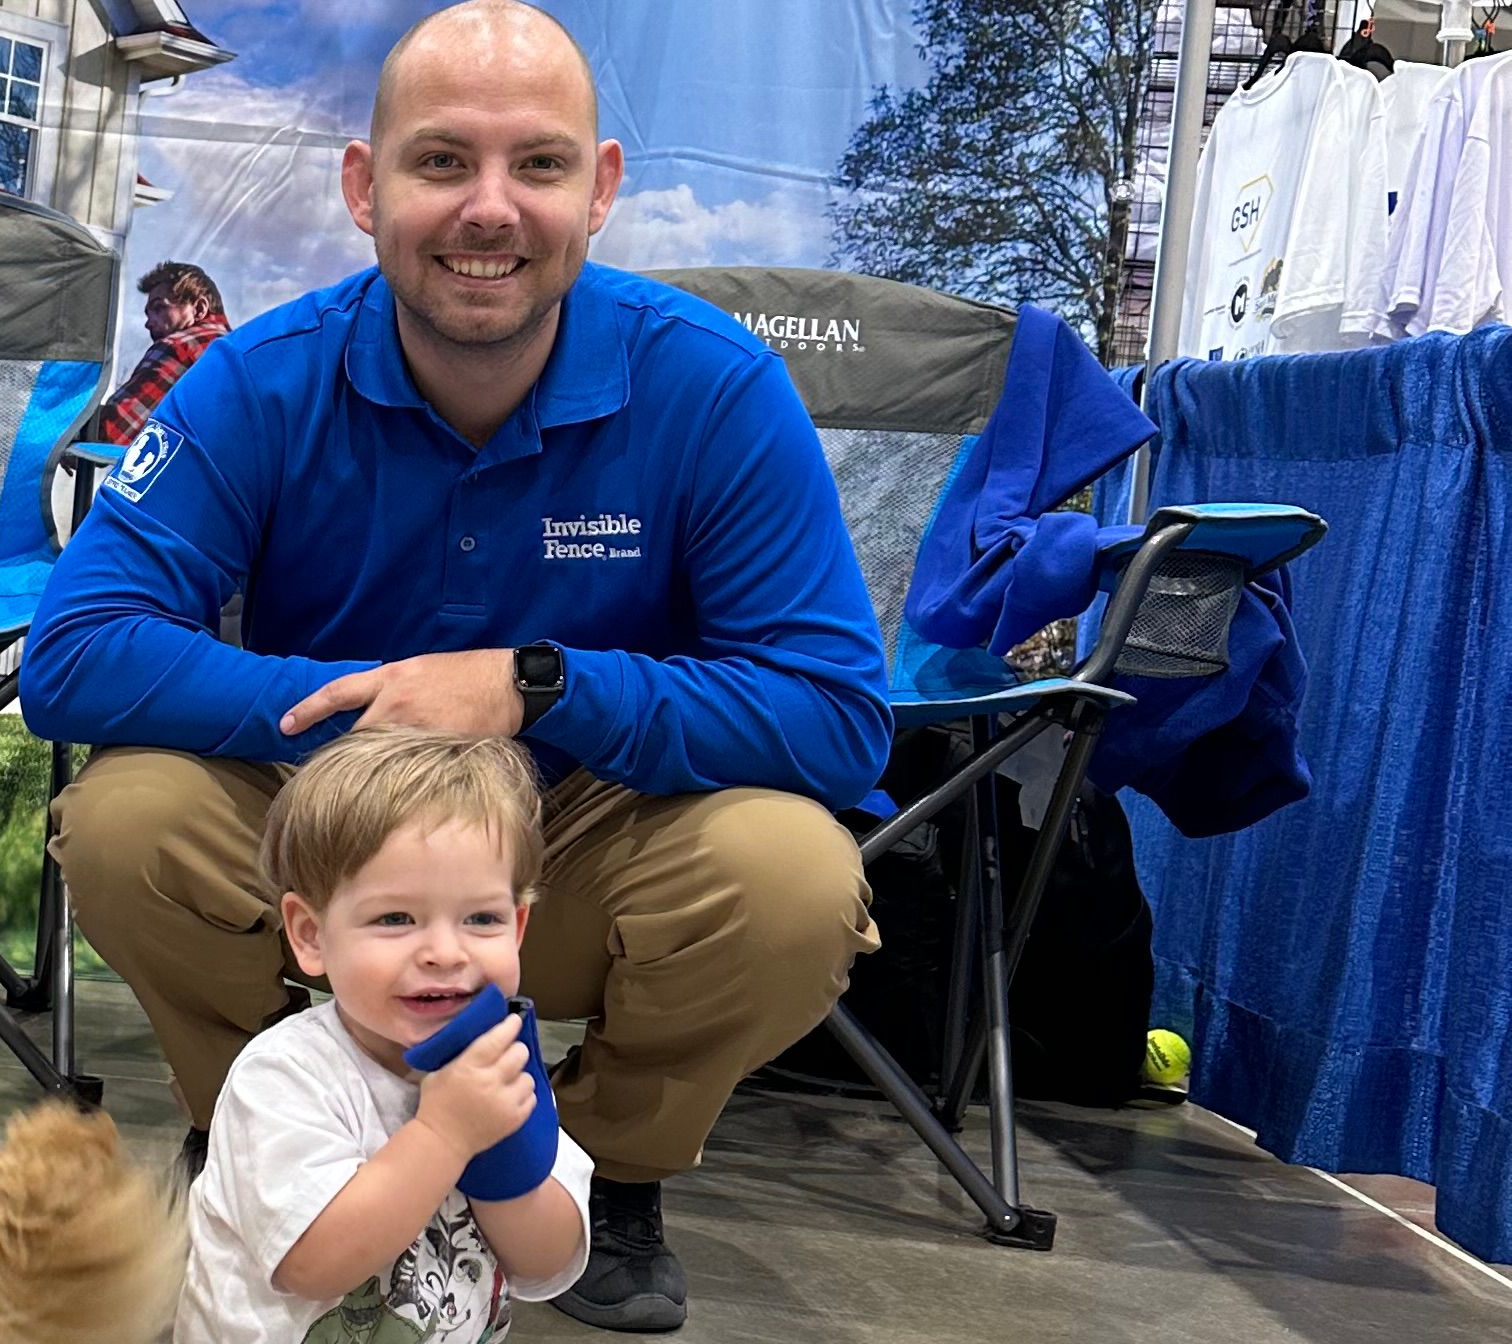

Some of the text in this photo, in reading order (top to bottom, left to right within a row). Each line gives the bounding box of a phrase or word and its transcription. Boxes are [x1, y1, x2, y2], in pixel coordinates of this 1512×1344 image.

[1231, 196, 1261, 233] GSH
[541, 514, 641, 536] Invisible
[543, 539, 605, 559] Fence
